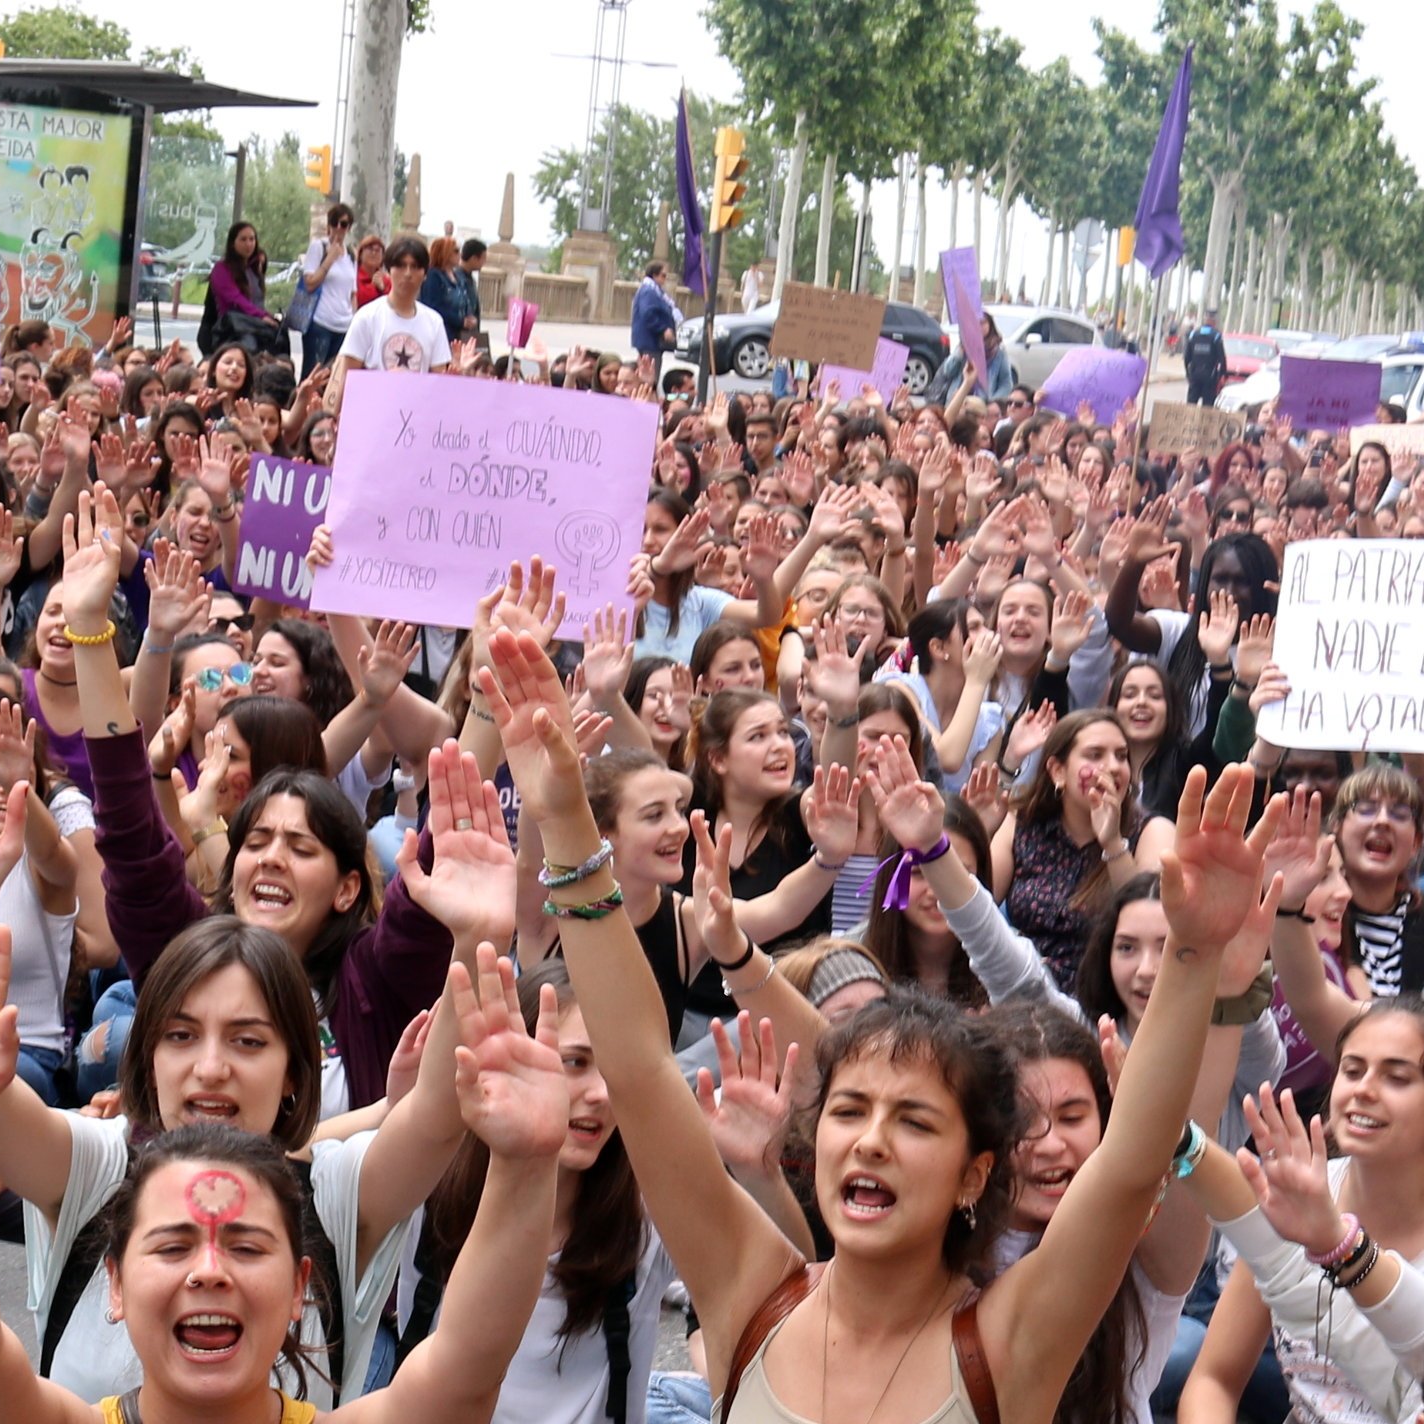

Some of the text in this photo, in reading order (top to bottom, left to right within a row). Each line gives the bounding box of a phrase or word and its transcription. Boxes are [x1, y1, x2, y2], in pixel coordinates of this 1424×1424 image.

[42, 115, 103, 141] MAJOR
[394, 409, 416, 448] Yo
[432, 421, 470, 450] decido
[479, 424, 489, 450] el
[253, 459, 295, 506] NI
[378, 507, 502, 550] y CON QUIÉN
[237, 541, 276, 589] NI
[1289, 553, 1320, 605] AL
[1313, 618, 1410, 675] NADIE
[1281, 690, 1324, 732] HA
